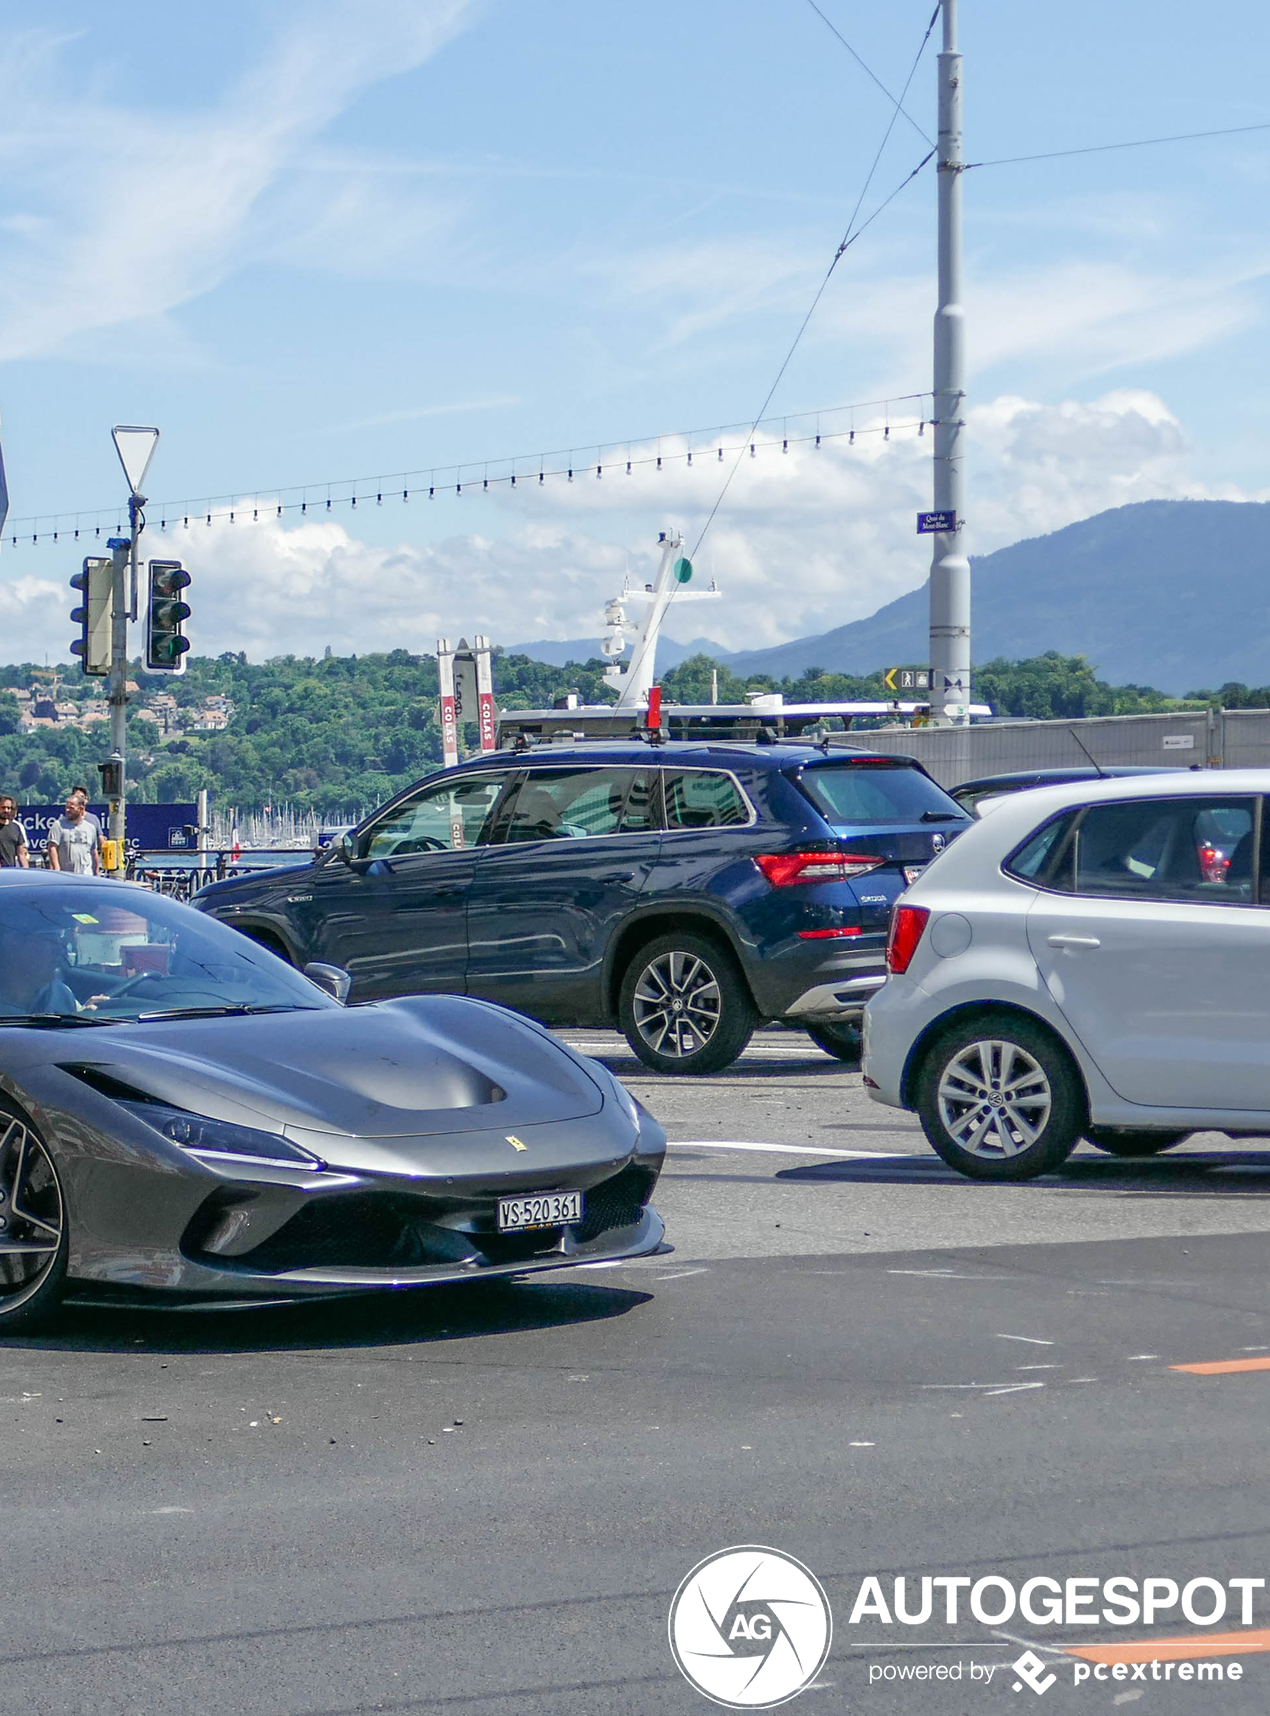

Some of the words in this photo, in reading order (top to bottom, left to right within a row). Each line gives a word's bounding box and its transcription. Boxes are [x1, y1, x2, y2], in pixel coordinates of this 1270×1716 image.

[444, 706, 454, 743] COLAS
[482, 703, 492, 740] COLAS
[17, 813, 64, 830] icke
[553, 1195, 577, 1219] 361
